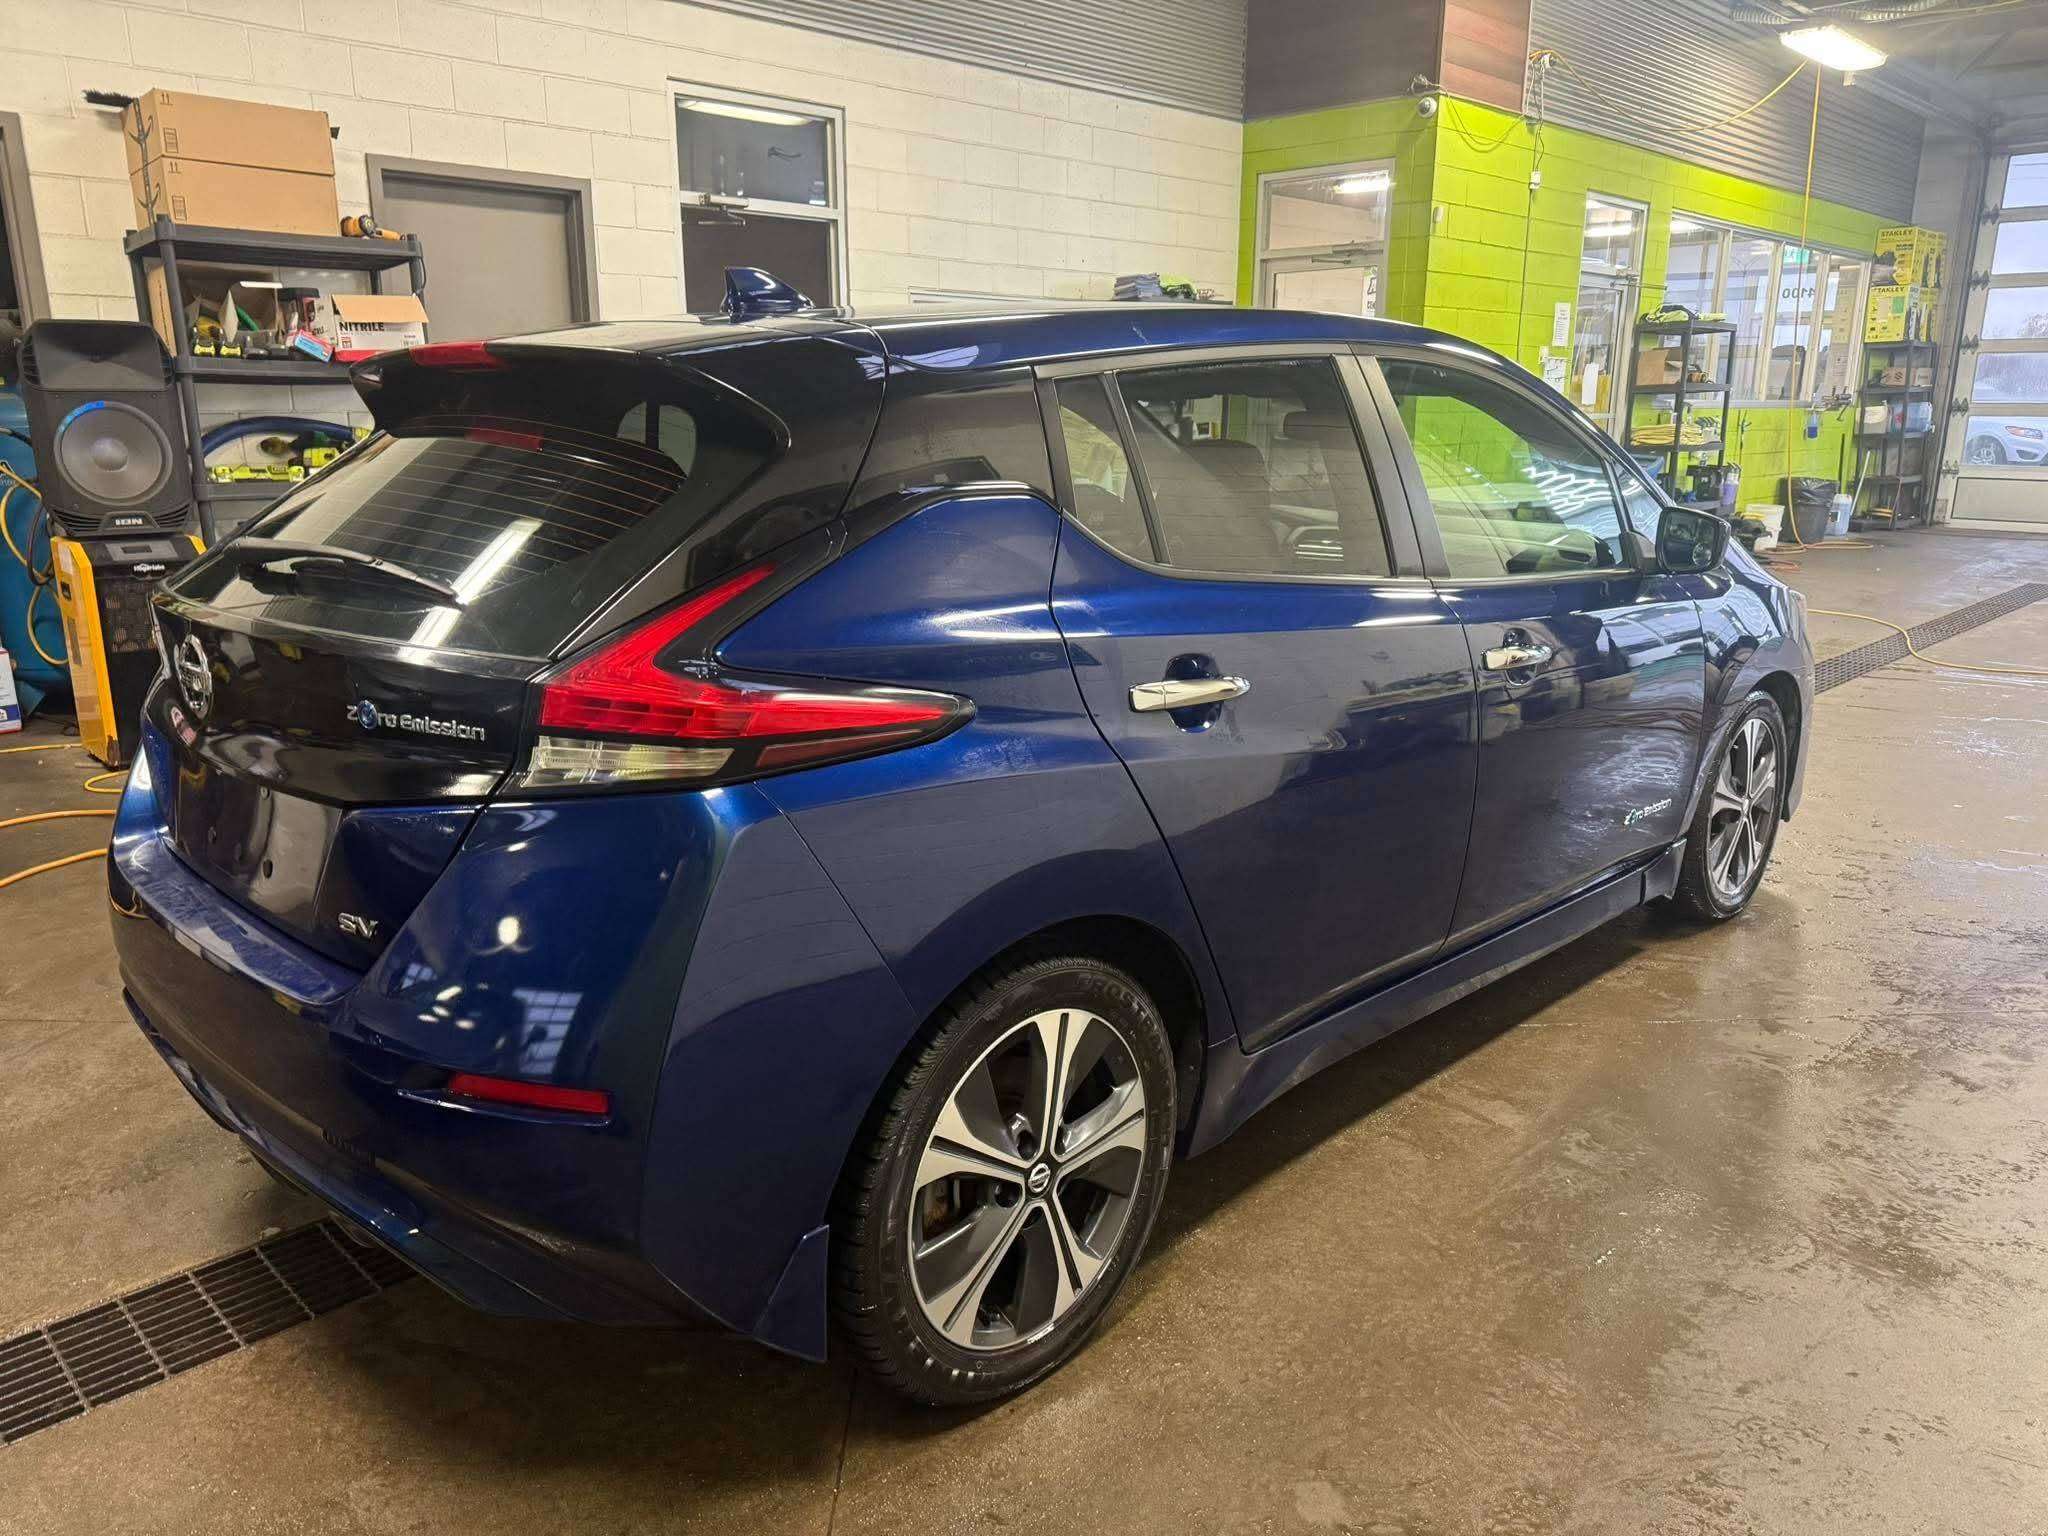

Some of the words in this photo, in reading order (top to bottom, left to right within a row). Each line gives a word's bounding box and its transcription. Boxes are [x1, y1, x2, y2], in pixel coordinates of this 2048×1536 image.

[339, 321, 385, 332] NITRILE
[400, 713, 485, 741] Emission
[338, 912, 379, 938] SV
